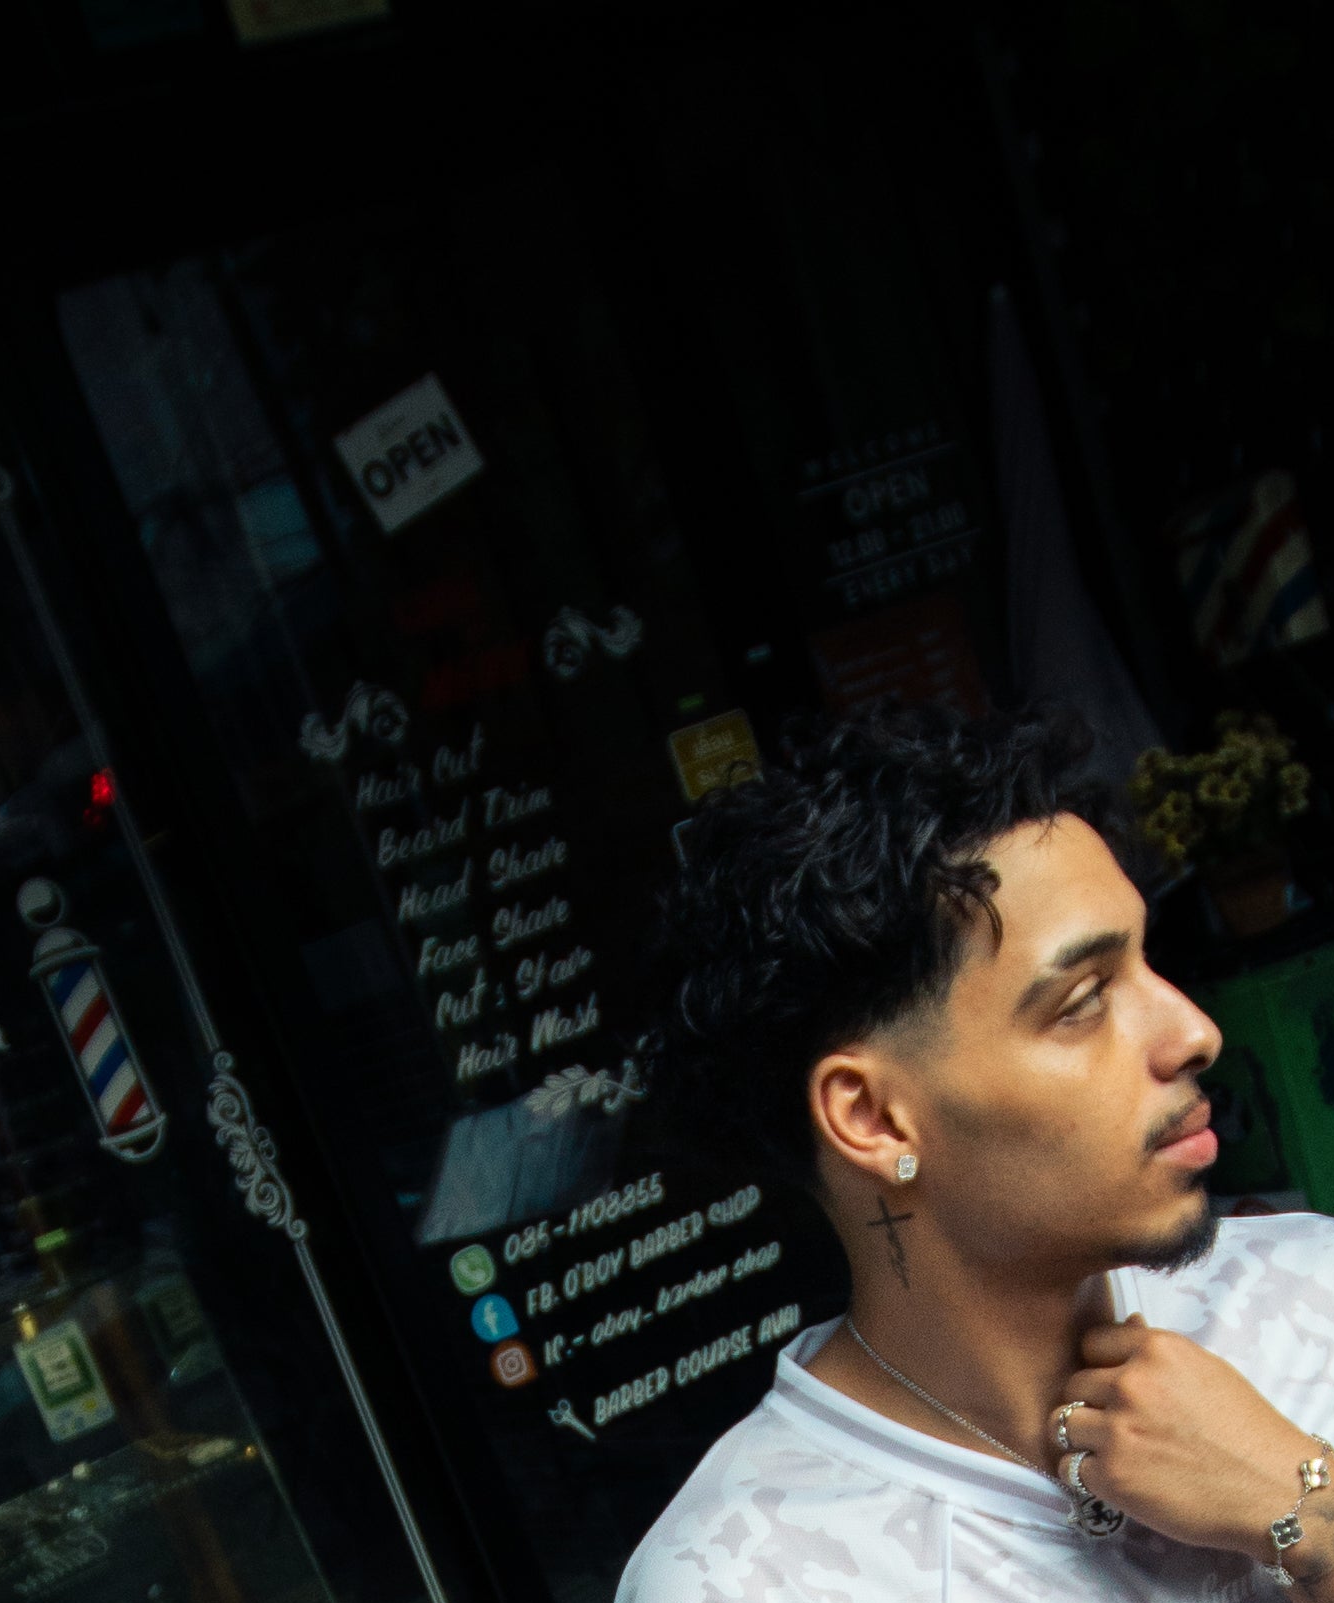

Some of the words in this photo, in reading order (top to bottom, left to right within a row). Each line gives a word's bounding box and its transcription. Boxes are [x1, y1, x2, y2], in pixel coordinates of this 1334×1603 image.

[362, 411, 461, 502] OPEN
[801, 415, 941, 483] WELCOME
[841, 468, 932, 527] OPEN
[842, 560, 919, 612] EVERY
[924, 543, 975, 579] DAY
[431, 720, 486, 785] Cut
[376, 795, 470, 871] Beard
[481, 780, 554, 831] Trim
[397, 856, 475, 924] Head
[486, 833, 570, 894] Shave
[418, 933, 481, 978] Face
[491, 894, 571, 952] Shave
[435, 965, 488, 1032] Cut
[455, 1031, 518, 1082] Hair
[528, 990, 602, 1055] Wash
[562, 1246, 628, 1302] O'BOY
[628, 1209, 706, 1271] BARBER
[706, 1182, 763, 1229] SHOP
[730, 1240, 783, 1283] shop
[593, 1364, 671, 1428] BARBER
[674, 1323, 755, 1389] COURSE
